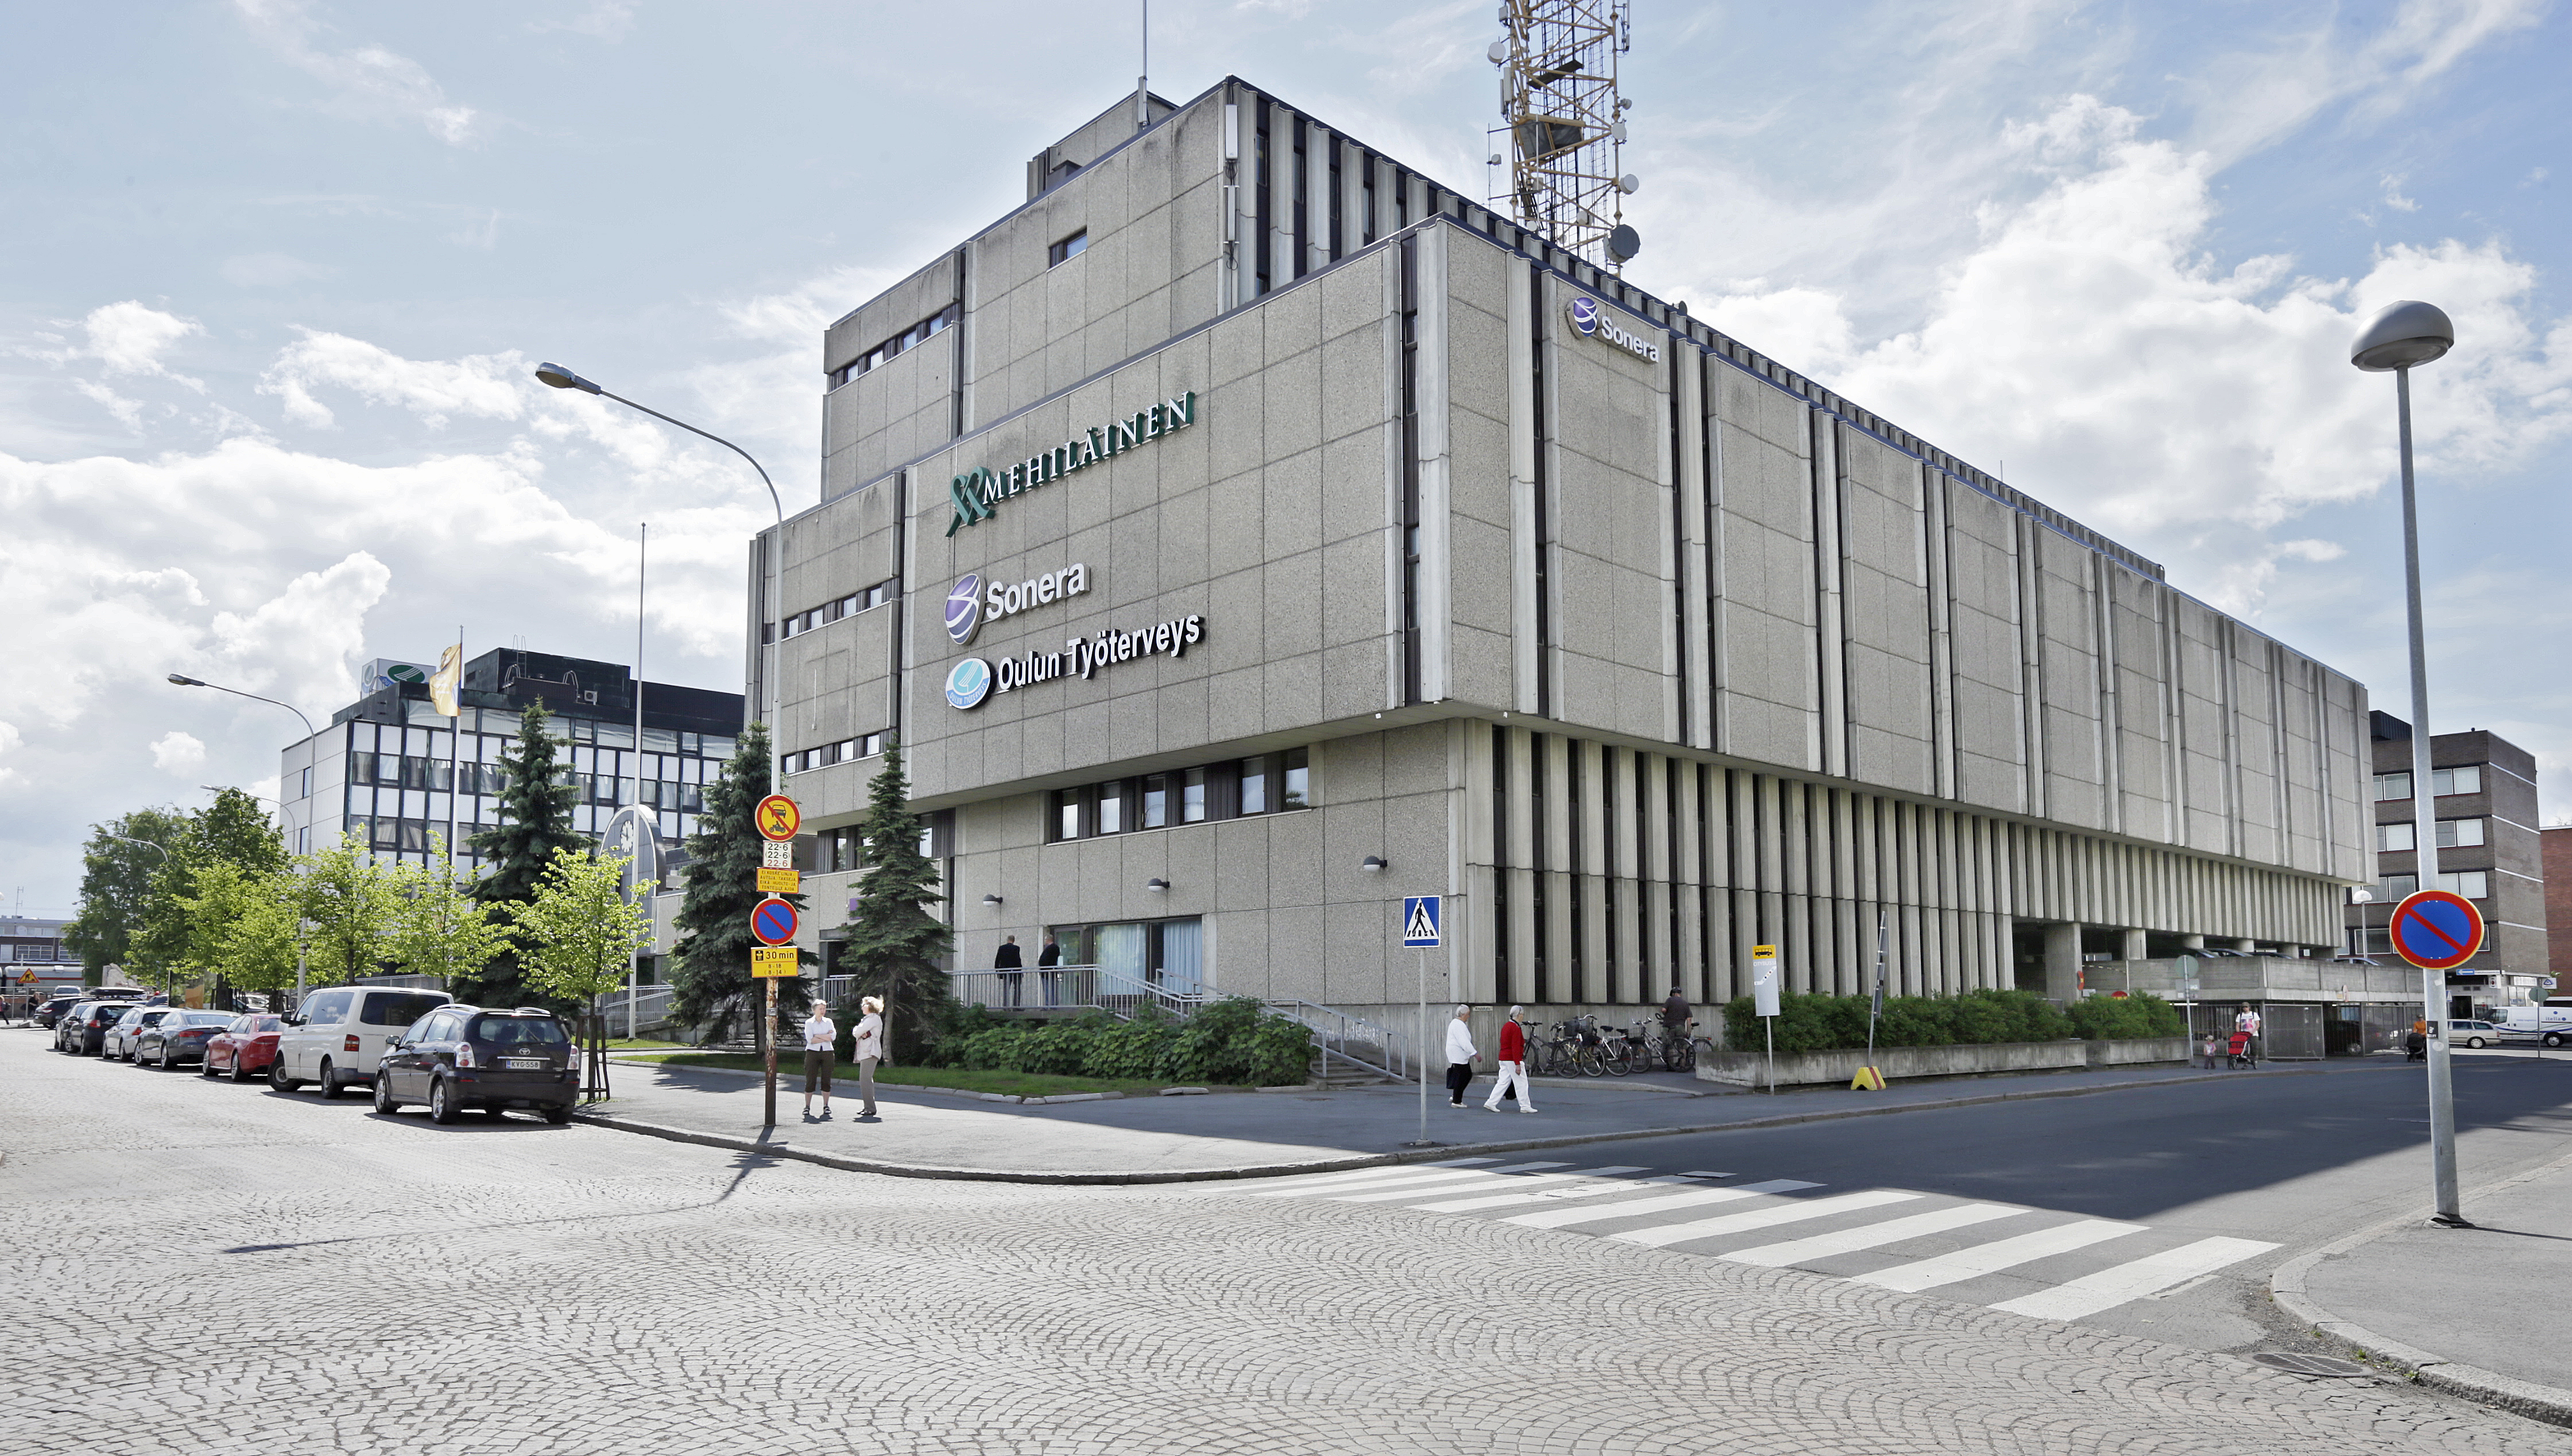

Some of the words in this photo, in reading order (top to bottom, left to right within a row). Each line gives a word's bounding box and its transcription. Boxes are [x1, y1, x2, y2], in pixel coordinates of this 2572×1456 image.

[1601, 316, 1659, 363] Sonera
[982, 391, 1195, 505] MEHILÄINEN
[986, 563, 1089, 619] Sonera
[998, 651, 1060, 690] Oulun
[1067, 614, 1201, 679] Työterveys
[765, 851, 790, 859] (22-6)
[768, 843, 788, 851] 22-6
[768, 859, 788, 867] 22-6
[766, 951, 777, 959] 30
[779, 951, 794, 959] min
